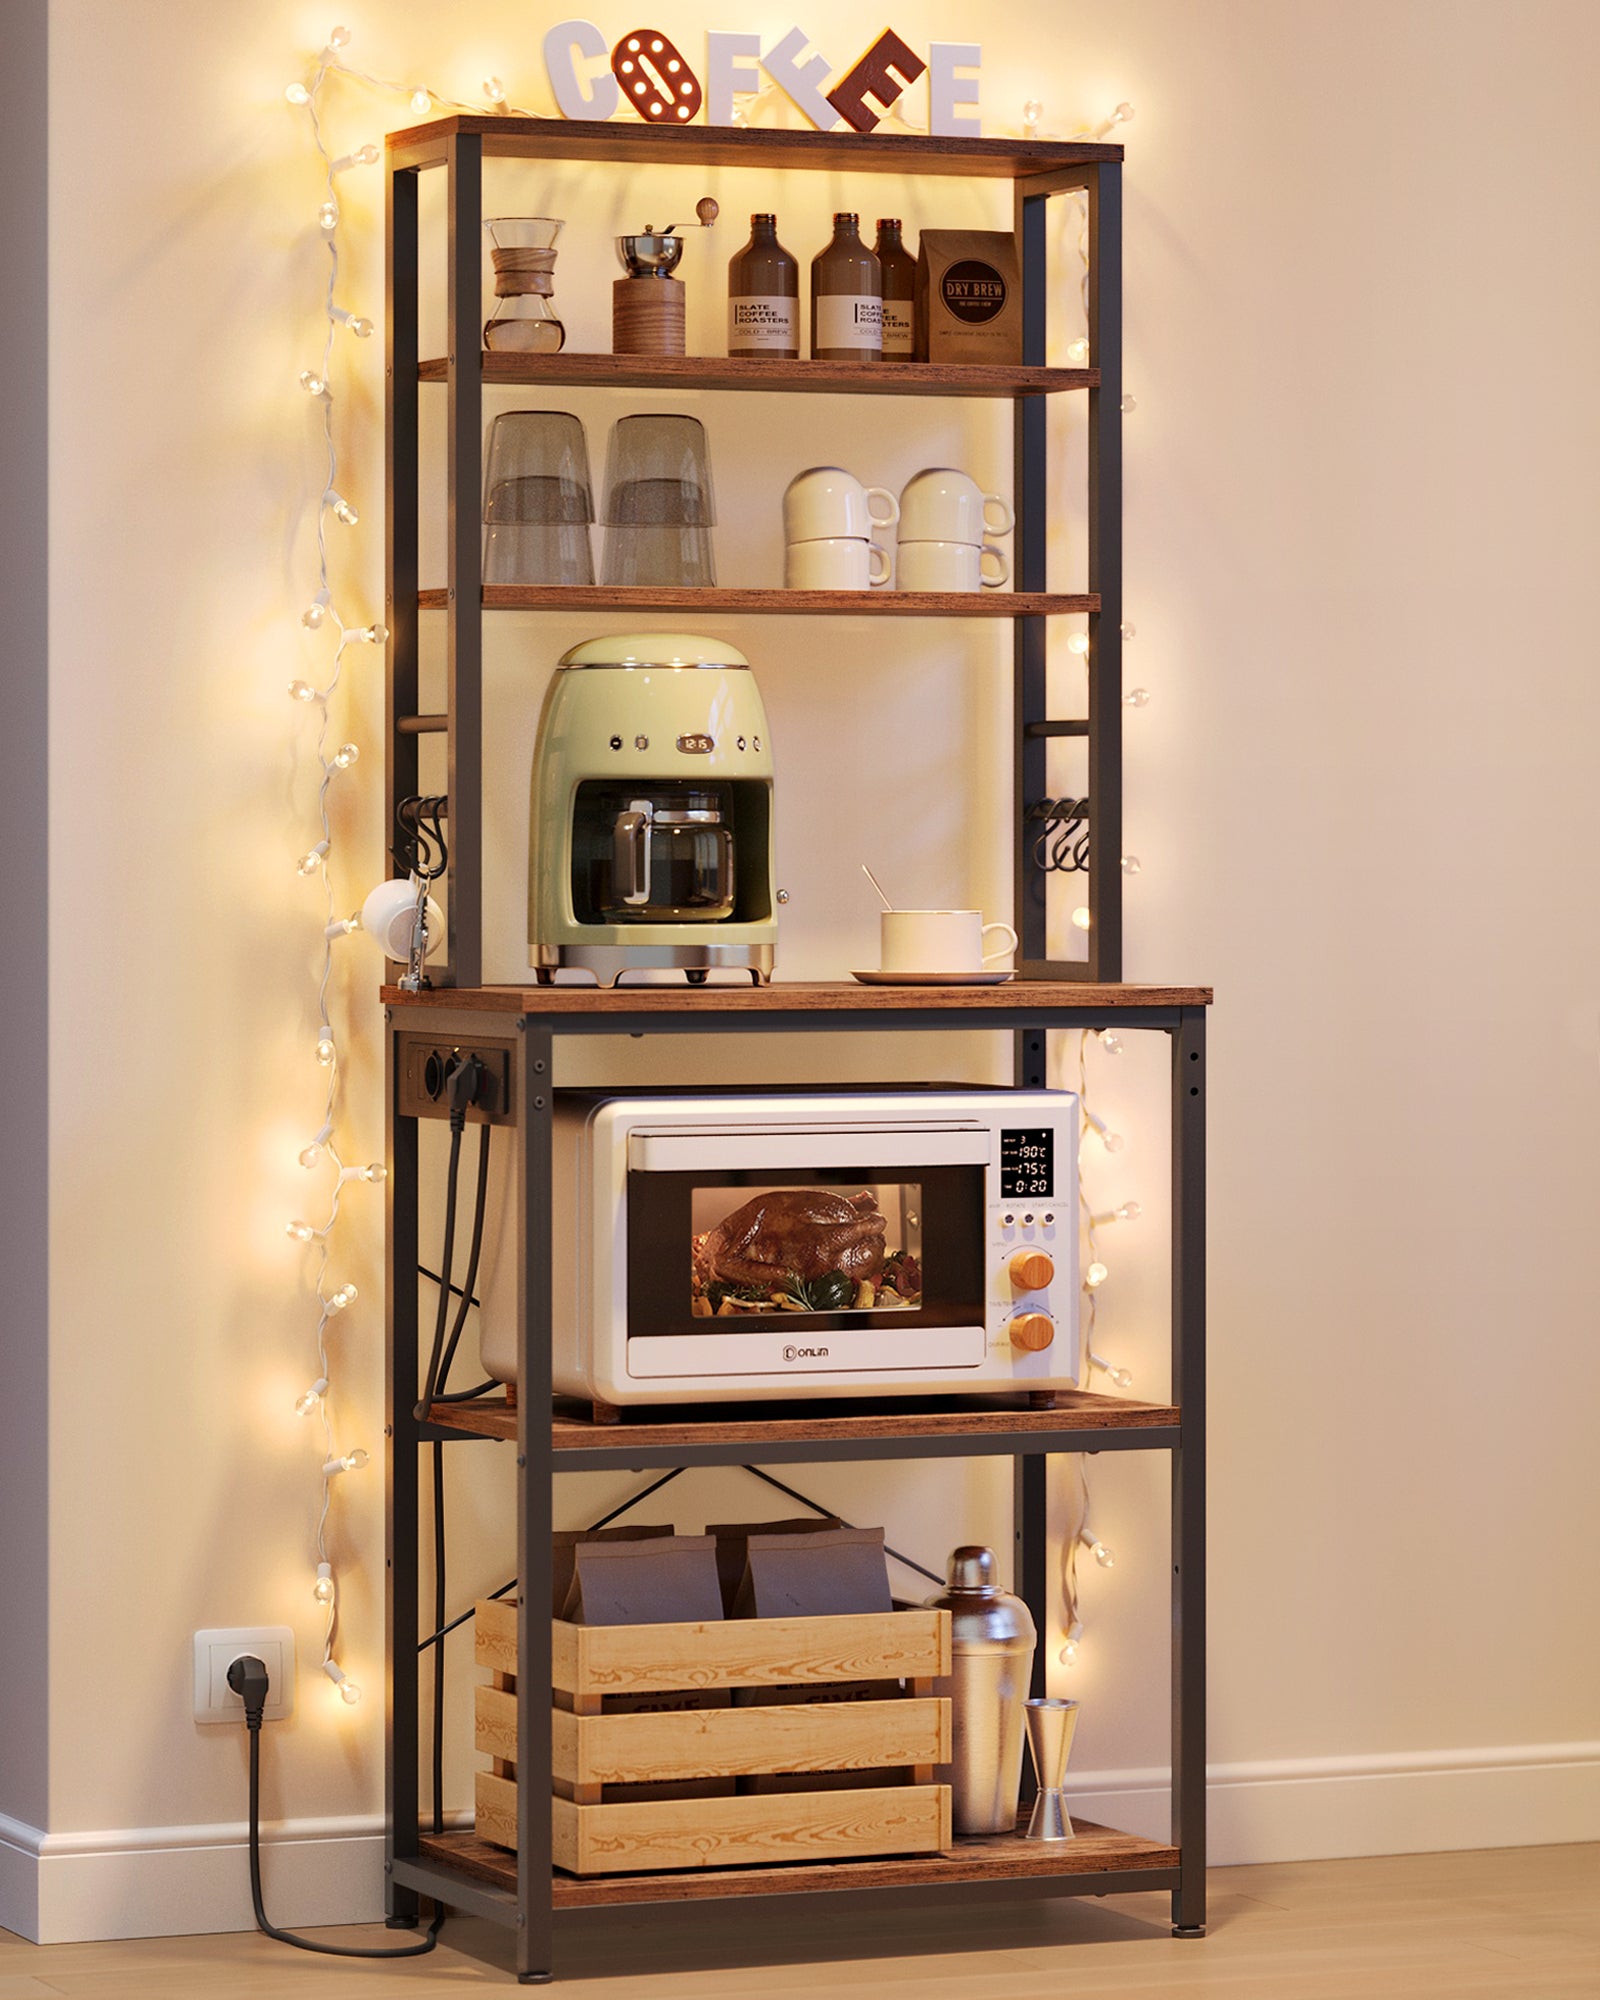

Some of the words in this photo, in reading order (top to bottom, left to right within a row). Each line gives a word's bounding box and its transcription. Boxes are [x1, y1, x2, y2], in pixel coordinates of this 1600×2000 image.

[543, 18, 982, 138] COFFEE
[946, 283, 969, 296] DRY
[973, 283, 1002, 297] BREW
[685, 738, 708, 749] 12:15
[1020, 1135, 1026, 1145] 3
